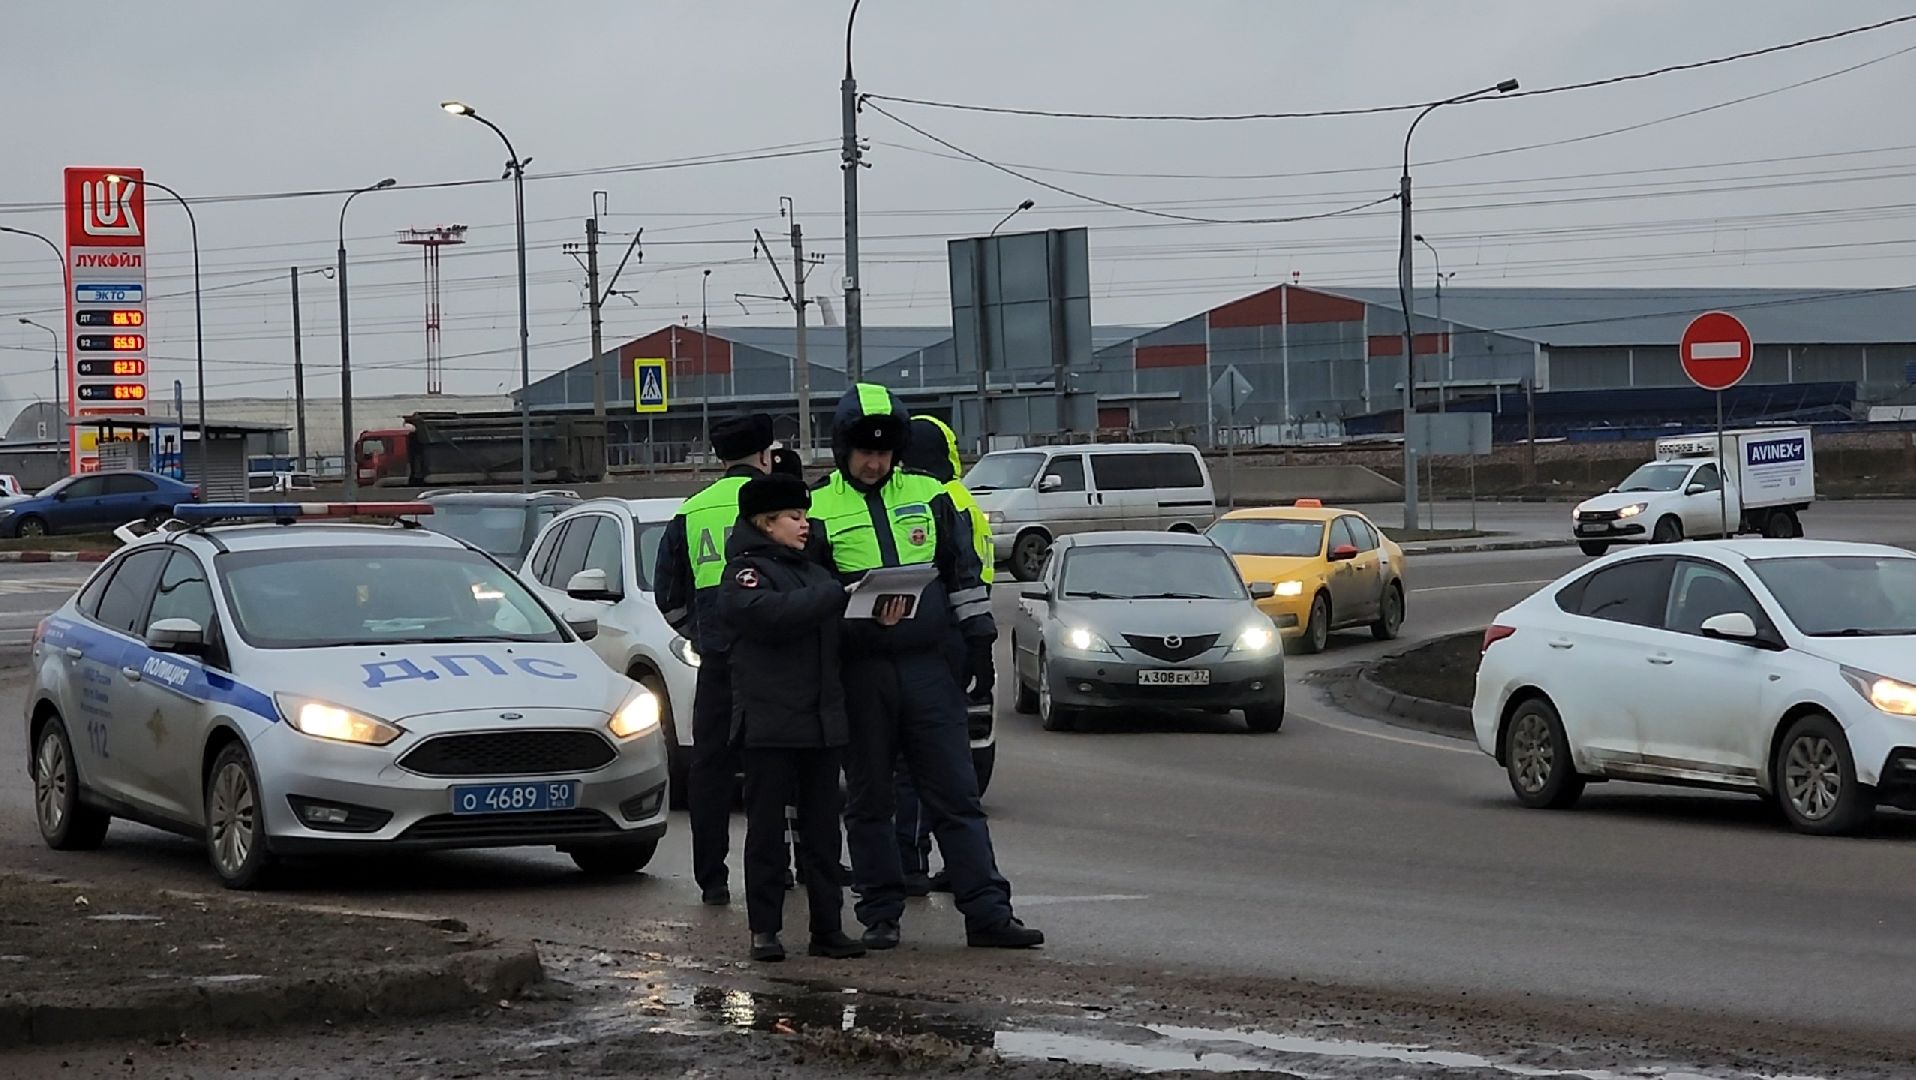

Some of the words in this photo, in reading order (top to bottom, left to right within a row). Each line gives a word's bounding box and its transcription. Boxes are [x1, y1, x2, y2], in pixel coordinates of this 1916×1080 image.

[76, 252, 142, 267] ЛУКОЙЛ
[95, 291, 125, 300] ЭКТО
[1752, 443, 1795, 461] AVINEX
[143, 656, 190, 686] ПОЛИЦИЯ
[361, 655, 578, 688] ДПС
[485, 787, 537, 810] 4689
[549, 785, 569, 800] 50
